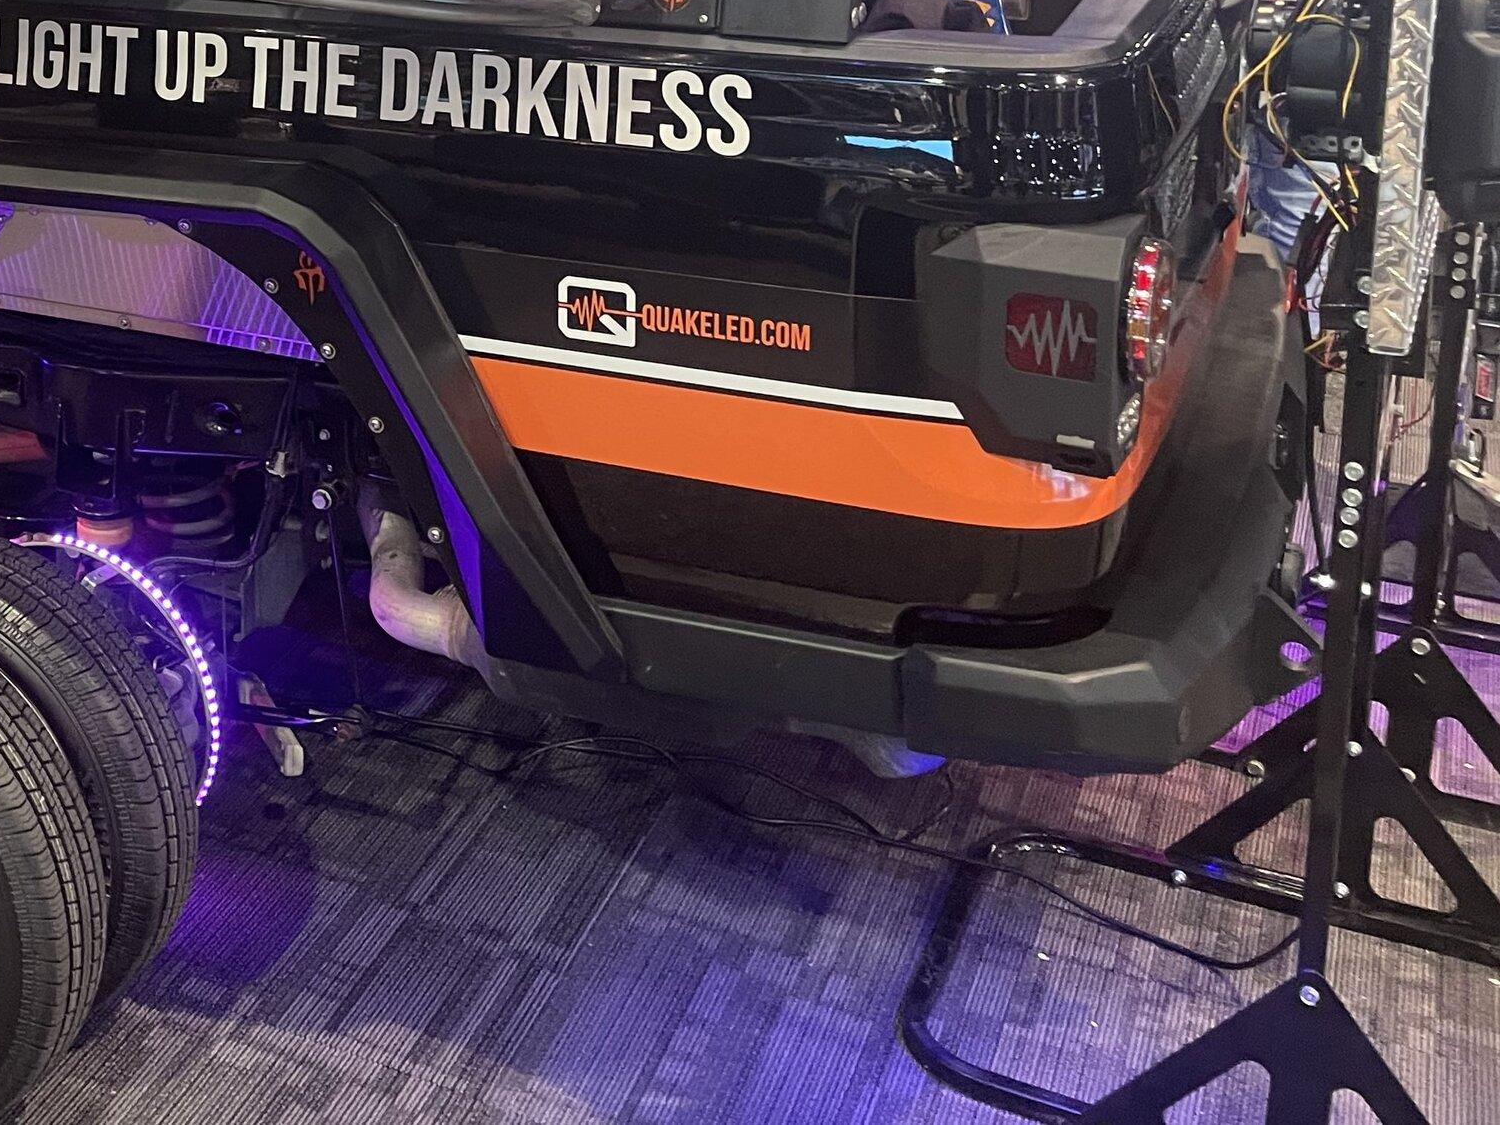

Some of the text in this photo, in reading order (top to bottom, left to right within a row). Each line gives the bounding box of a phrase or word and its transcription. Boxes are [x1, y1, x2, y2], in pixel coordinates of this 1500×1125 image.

[153, 28, 228, 104] UP
[243, 35, 363, 119] THE
[379, 47, 754, 157] DARKNESS
[641, 303, 811, 352] QUAKELED.COM
